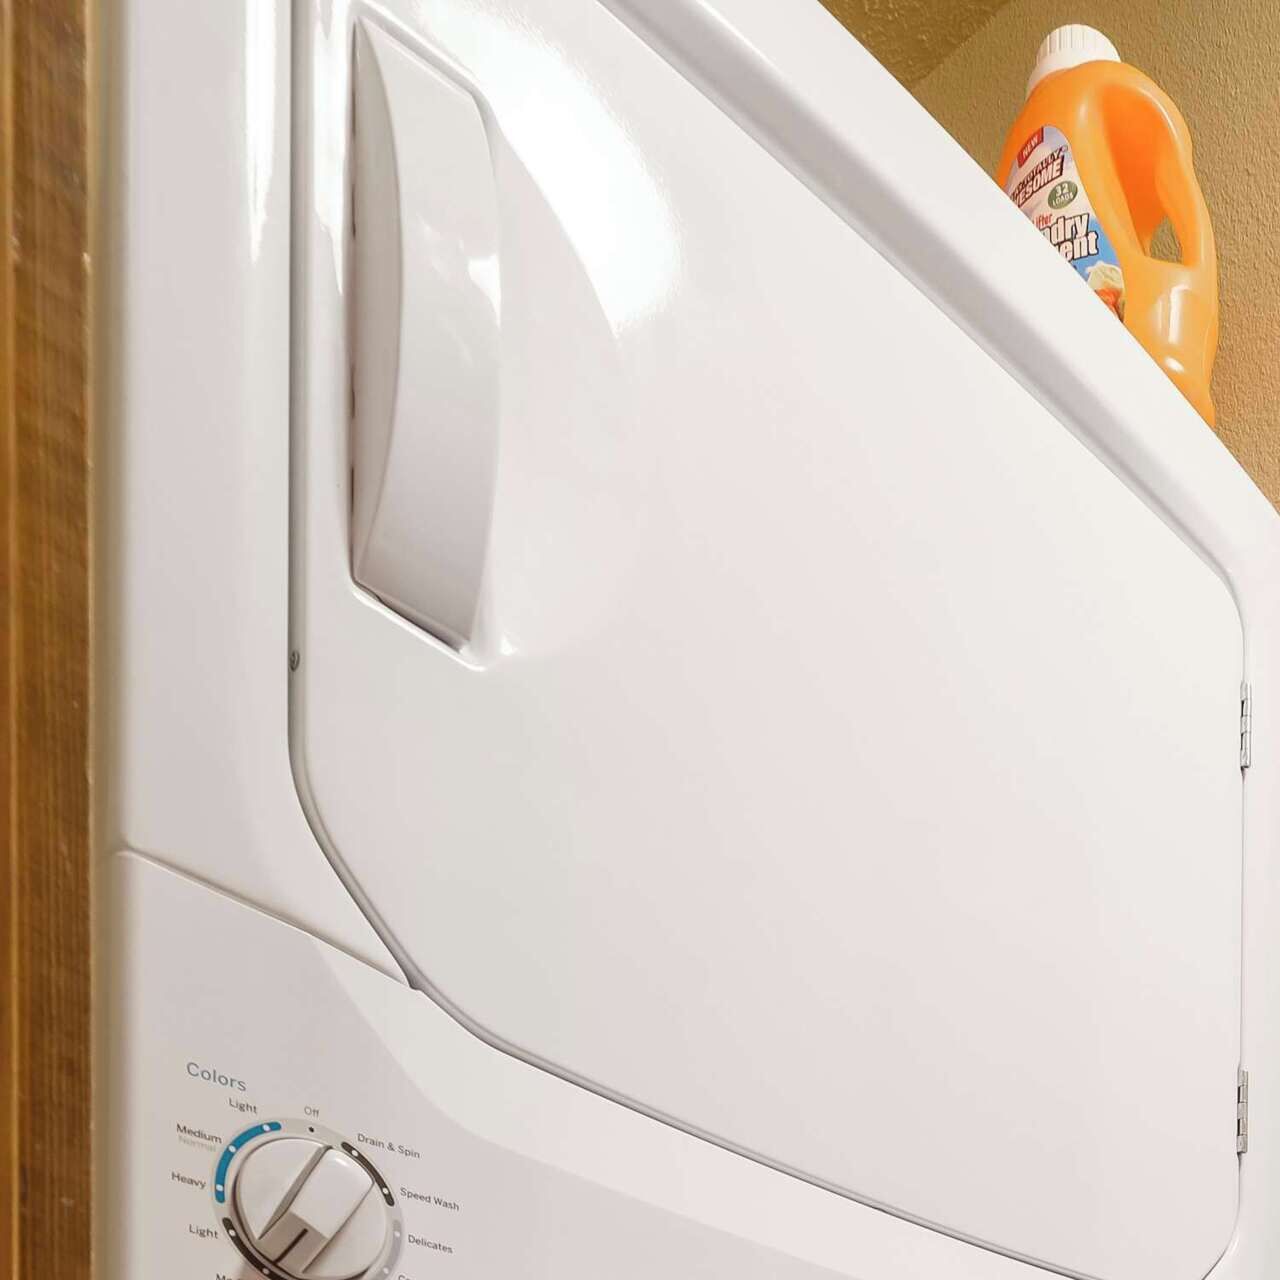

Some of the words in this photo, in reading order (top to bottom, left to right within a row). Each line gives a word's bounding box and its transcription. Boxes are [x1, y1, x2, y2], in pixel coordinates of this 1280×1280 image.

[1022, 134, 1038, 157] NEW
[1056, 183, 1068, 197] 32
[1056, 232, 1098, 261] ent
[186, 1061, 247, 1092] Colors
[228, 1098, 258, 1114] Light
[304, 1107, 320, 1118] Off
[176, 1123, 222, 1144] Medium
[357, 1133, 385, 1148] Drain
[388, 1141, 395, 1151] &
[397, 1144, 420, 1159] Spin
[171, 1171, 206, 1190] Heavy
[400, 1187, 431, 1205] Speed
[433, 1195, 459, 1212] Wash
[188, 1224, 219, 1239] Light
[408, 1235, 453, 1254] Delicates
